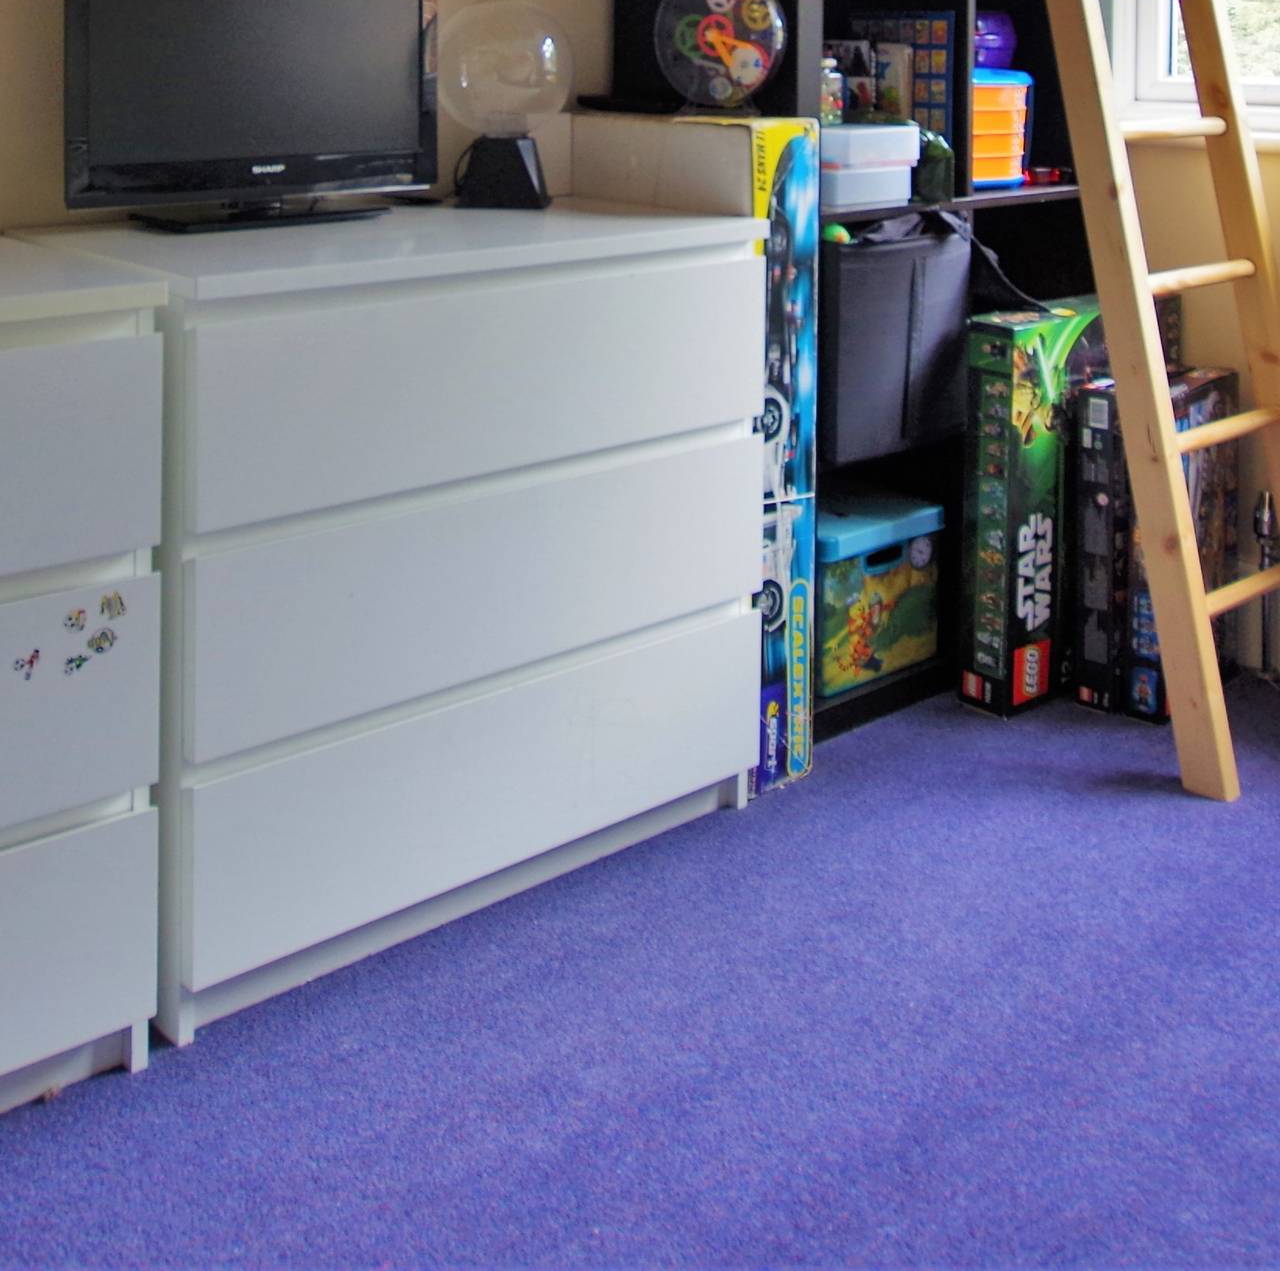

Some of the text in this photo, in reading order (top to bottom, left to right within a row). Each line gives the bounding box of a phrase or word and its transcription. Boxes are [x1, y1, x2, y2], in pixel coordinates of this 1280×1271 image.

[252, 164, 285, 174] SHARP
[1016, 513, 1036, 632] STAR
[1033, 512, 1053, 630] WARS
[792, 595, 805, 759] SCALEXTRIC
[1024, 645, 1040, 695] LEGO
